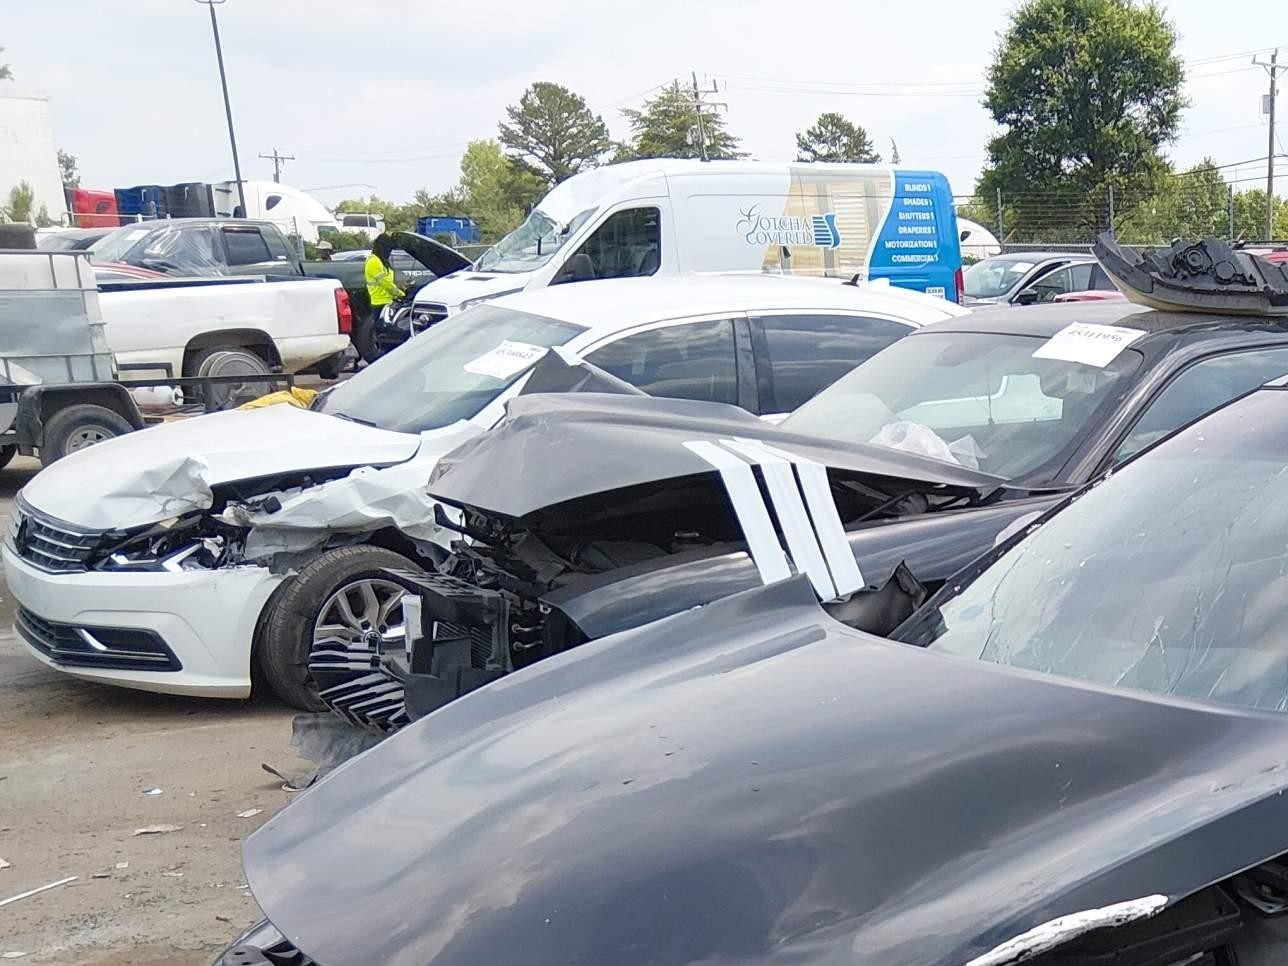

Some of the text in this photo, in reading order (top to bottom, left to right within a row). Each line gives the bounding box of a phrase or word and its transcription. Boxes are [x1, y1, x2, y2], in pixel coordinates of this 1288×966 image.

[904, 183, 928, 192] BLINDS
[903, 198, 929, 206] SHADES
[736, 203, 811, 232] GOTCHA
[898, 212, 931, 220] SHUTTERS
[898, 226, 932, 234] DRAPERIES
[745, 231, 813, 246] COVERED
[885, 240, 934, 249] MOTORIZATION
